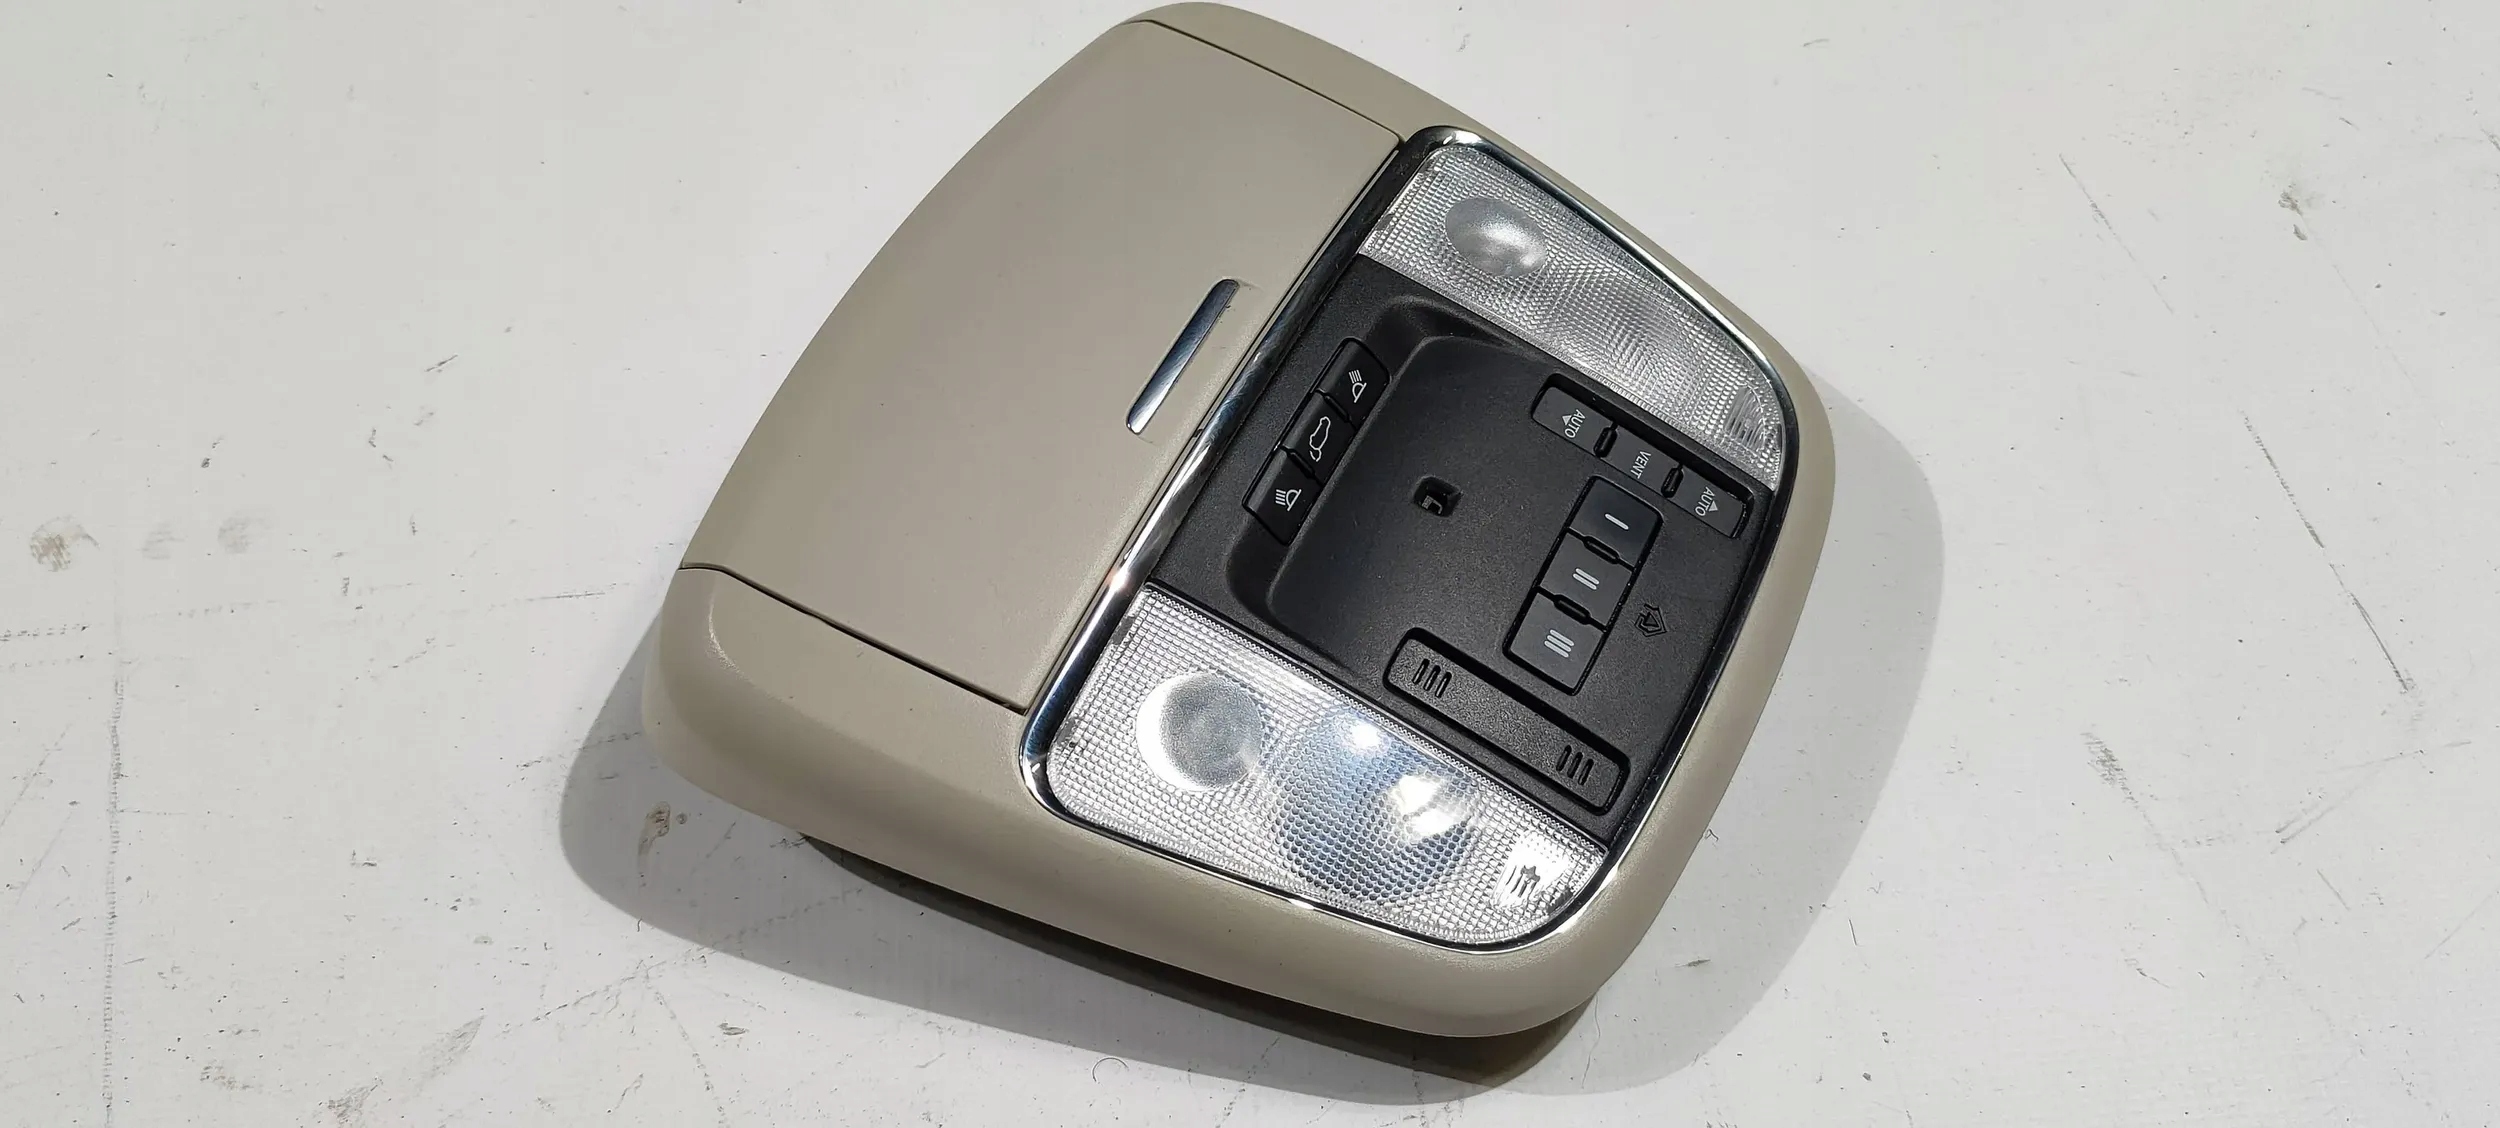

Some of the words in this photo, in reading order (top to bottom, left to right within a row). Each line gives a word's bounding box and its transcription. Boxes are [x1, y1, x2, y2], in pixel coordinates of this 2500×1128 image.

[1565, 409, 1586, 438] AUTO
[1630, 451, 1652, 479] VENT
[1695, 486, 1716, 516] AUTO
